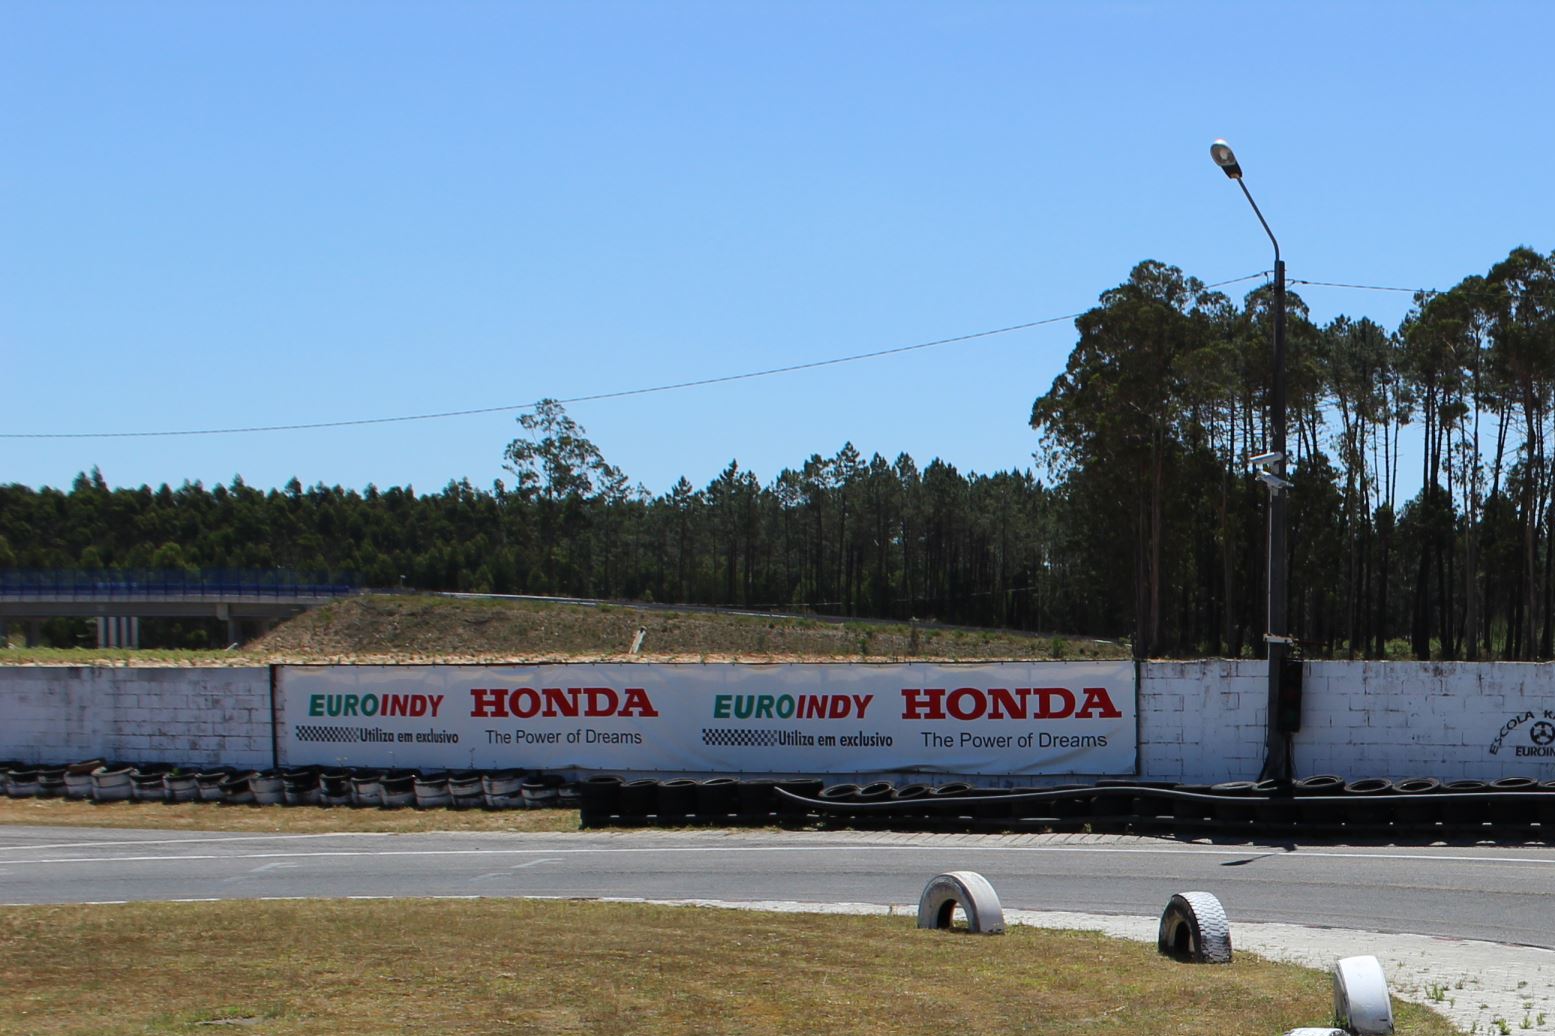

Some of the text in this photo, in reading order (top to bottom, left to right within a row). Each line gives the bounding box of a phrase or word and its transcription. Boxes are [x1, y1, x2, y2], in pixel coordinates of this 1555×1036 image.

[308, 693, 445, 717] EUROINDY
[470, 687, 659, 719] HONDA
[713, 694, 874, 719] EUROINDY
[901, 687, 1122, 721] HONDA
[359, 727, 459, 744] Utiliza em exclusivo
[484, 729, 642, 745] The Power of Dreams
[778, 729, 894, 748] Utiliza em exclusivo
[920, 732, 1108, 749] The Power of Dreams
[1489, 711, 1535, 755] ESCOLA
